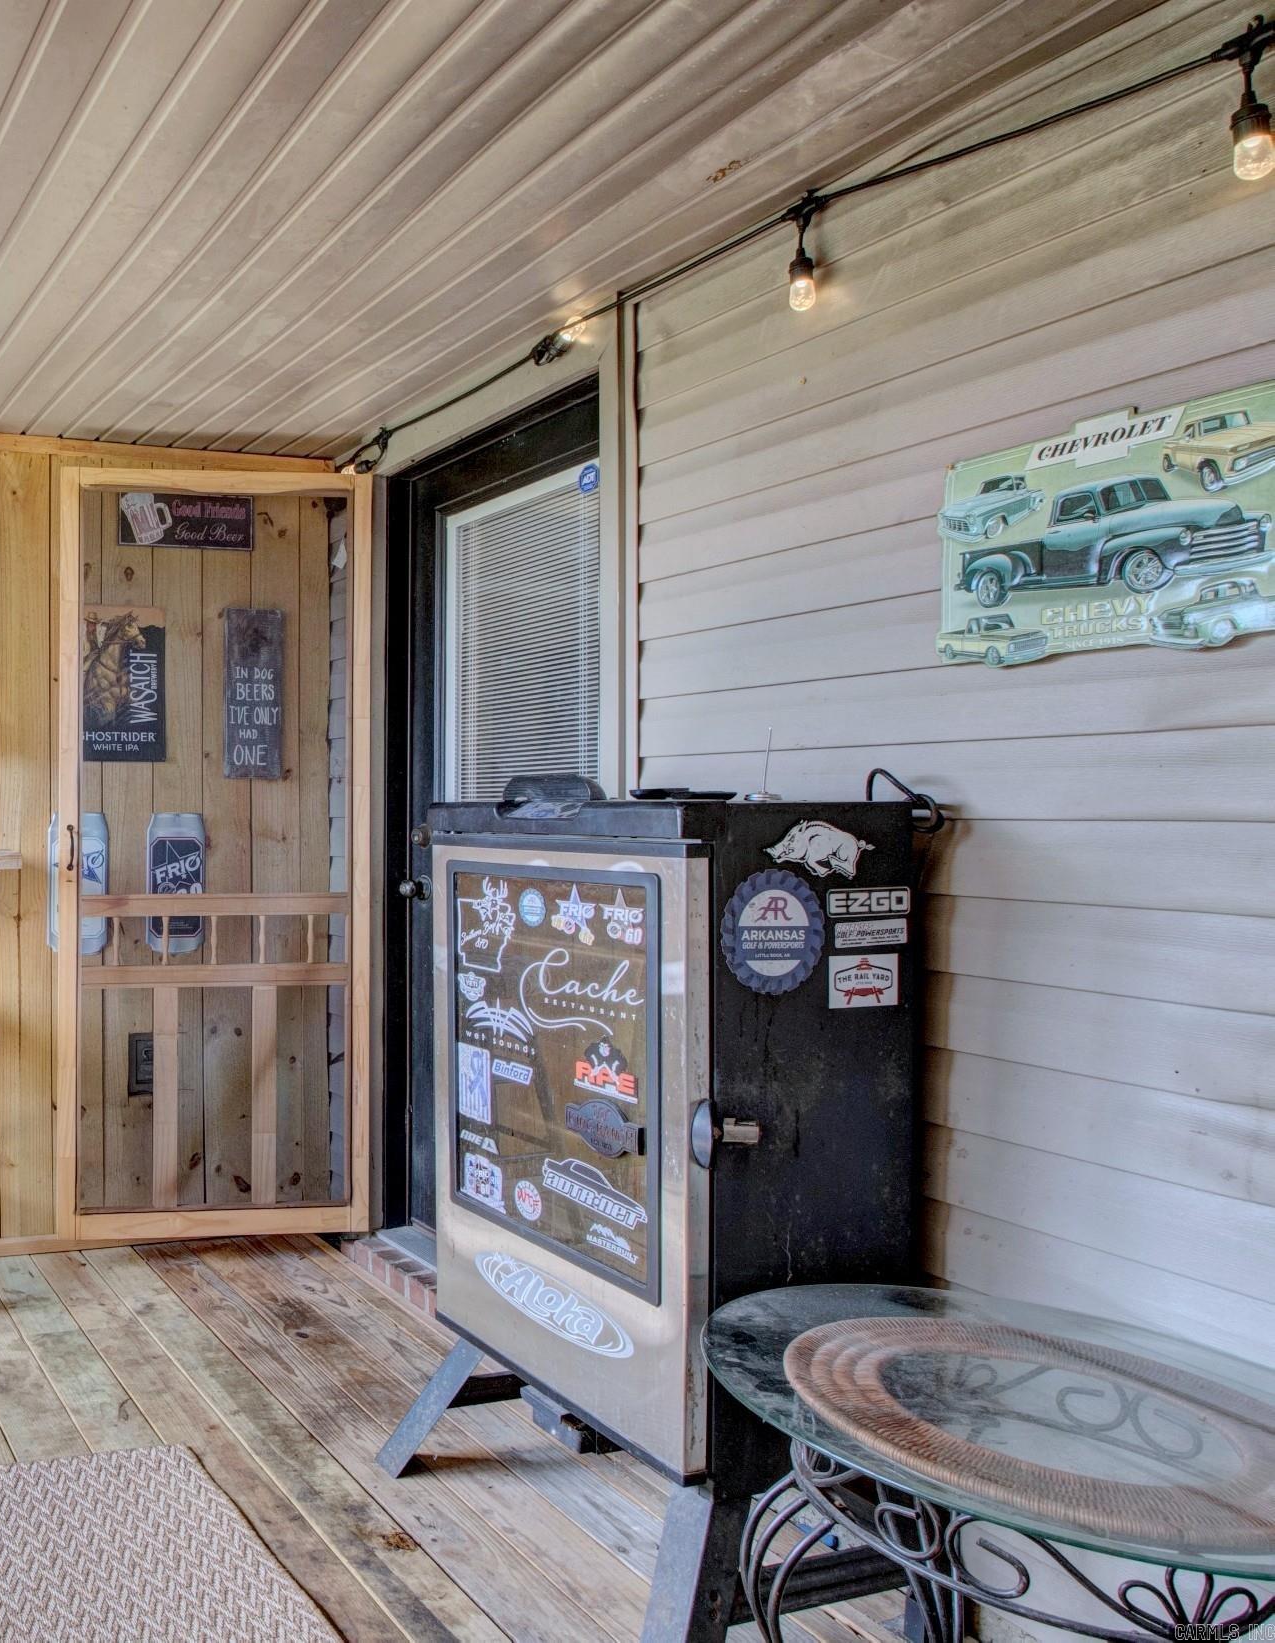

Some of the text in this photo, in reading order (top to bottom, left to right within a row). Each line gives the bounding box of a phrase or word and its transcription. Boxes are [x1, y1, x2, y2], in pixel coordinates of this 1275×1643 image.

[1037, 414, 1172, 461] CHEVROLET
[171, 499, 246, 520] Good Friends
[174, 521, 245, 543] Good Beer
[1041, 595, 1150, 626] CHEVY
[1051, 616, 1142, 640] TRUCKS
[150, 664, 158, 690] BREWERY
[235, 666, 274, 680] IN DOG
[129, 653, 157, 724] WASATCH
[236, 683, 275, 701] BEERS
[229, 705, 279, 726] I'VE ONLY
[83, 731, 156, 742] HOSTRIDER
[239, 729, 258, 740] HAD
[93, 743, 140, 752] WHITE IPA
[233, 744, 268, 766] ONE
[155, 855, 202, 885] FRIO
[559, 903, 596, 920] FRIO
[602, 905, 644, 924] FRIO
[741, 929, 806, 941] ARKANSAS
[856, 927, 905, 938] POWERSPORTS
[742, 942, 757, 950] GOLF
[764, 941, 806, 950] POWERSPORTS
[520, 948, 645, 1006] Cache
[837, 975, 853, 984] THE
[854, 972, 869, 980] RAIL
[872, 973, 890, 982] YARD
[543, 997, 637, 1021] RESTAURANT
[465, 1030, 536, 1056] wet sounds
[494, 1062, 531, 1082] Binford
[586, 1233, 640, 1265] MASTERBUILT
[498, 1265, 604, 1346] Aloha
